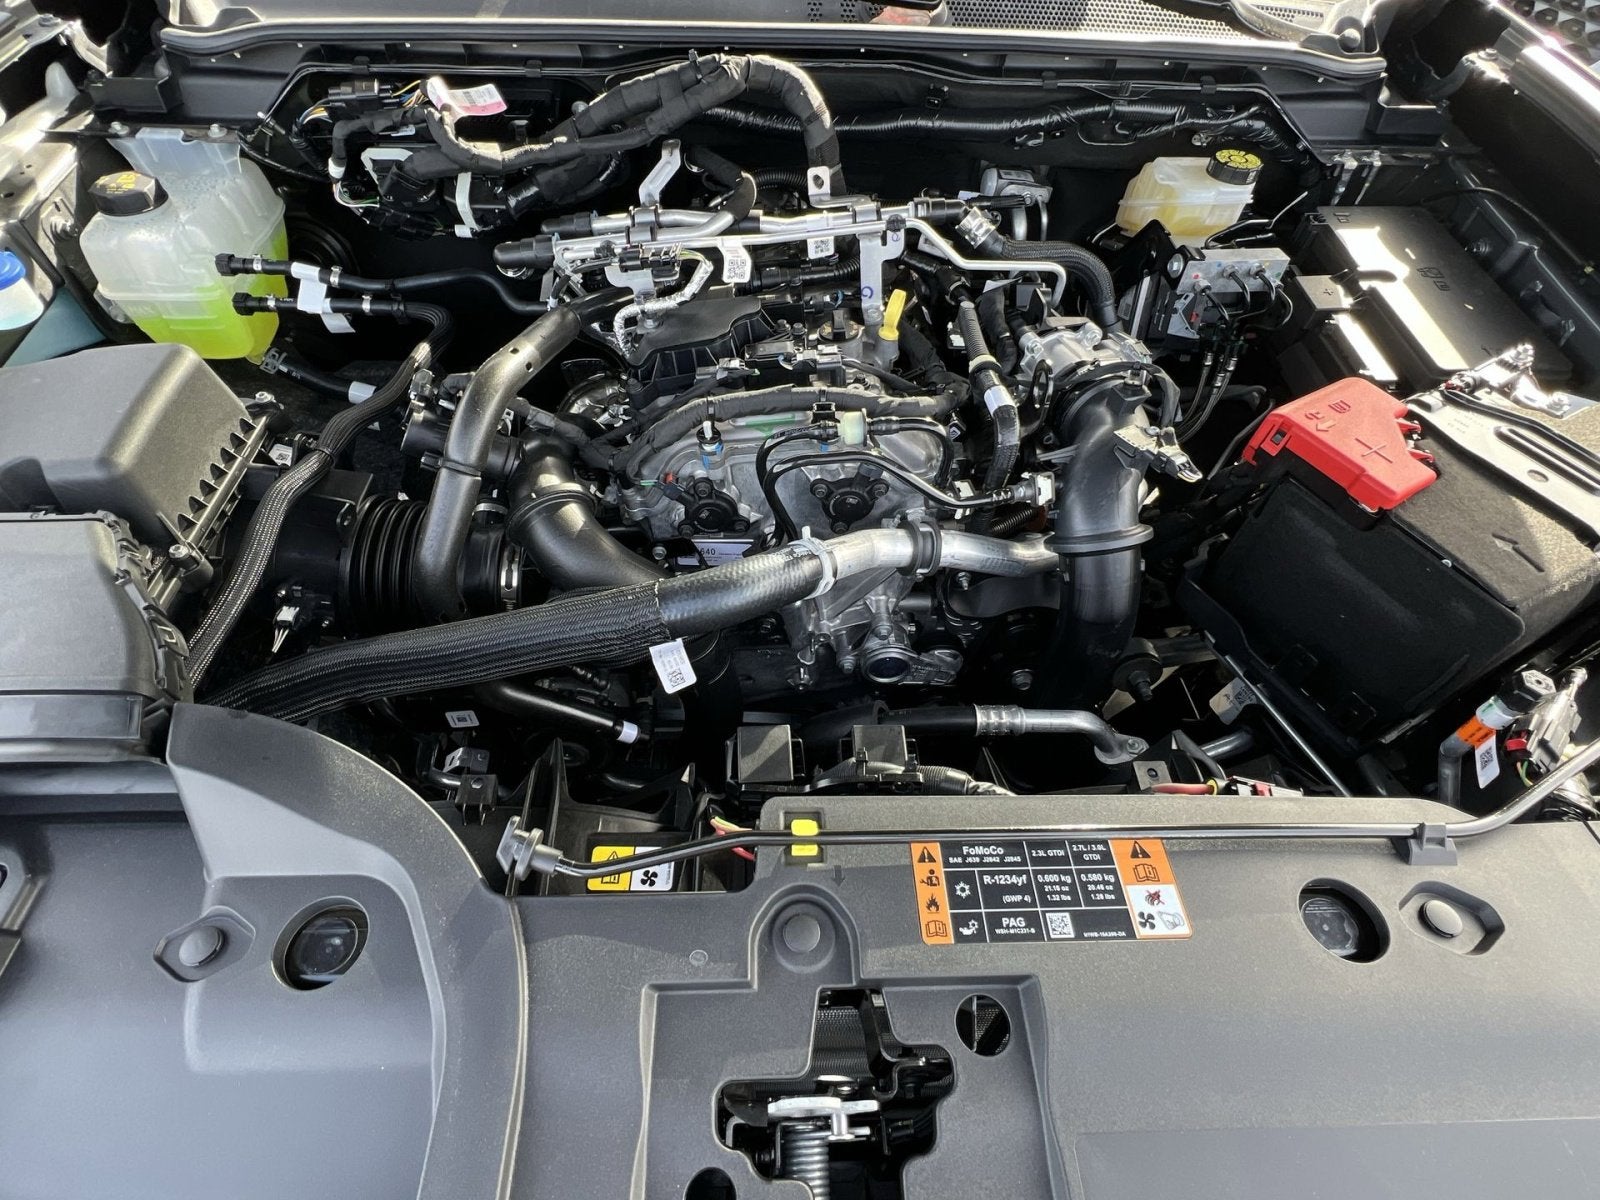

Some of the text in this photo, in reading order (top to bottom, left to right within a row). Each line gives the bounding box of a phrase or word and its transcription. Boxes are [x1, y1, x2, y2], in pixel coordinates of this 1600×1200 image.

[962, 845, 1004, 855] FoMoCo
[1048, 849, 1065, 857] GTDI
[982, 874, 1027, 886] R-1234yf
[1037, 874, 1072, 884] 0.600 kg
[1080, 873, 1115, 883] 0.580 kg
[1002, 894, 1031, 903] (GWP 4)
[1002, 917, 1026, 928] PAG
